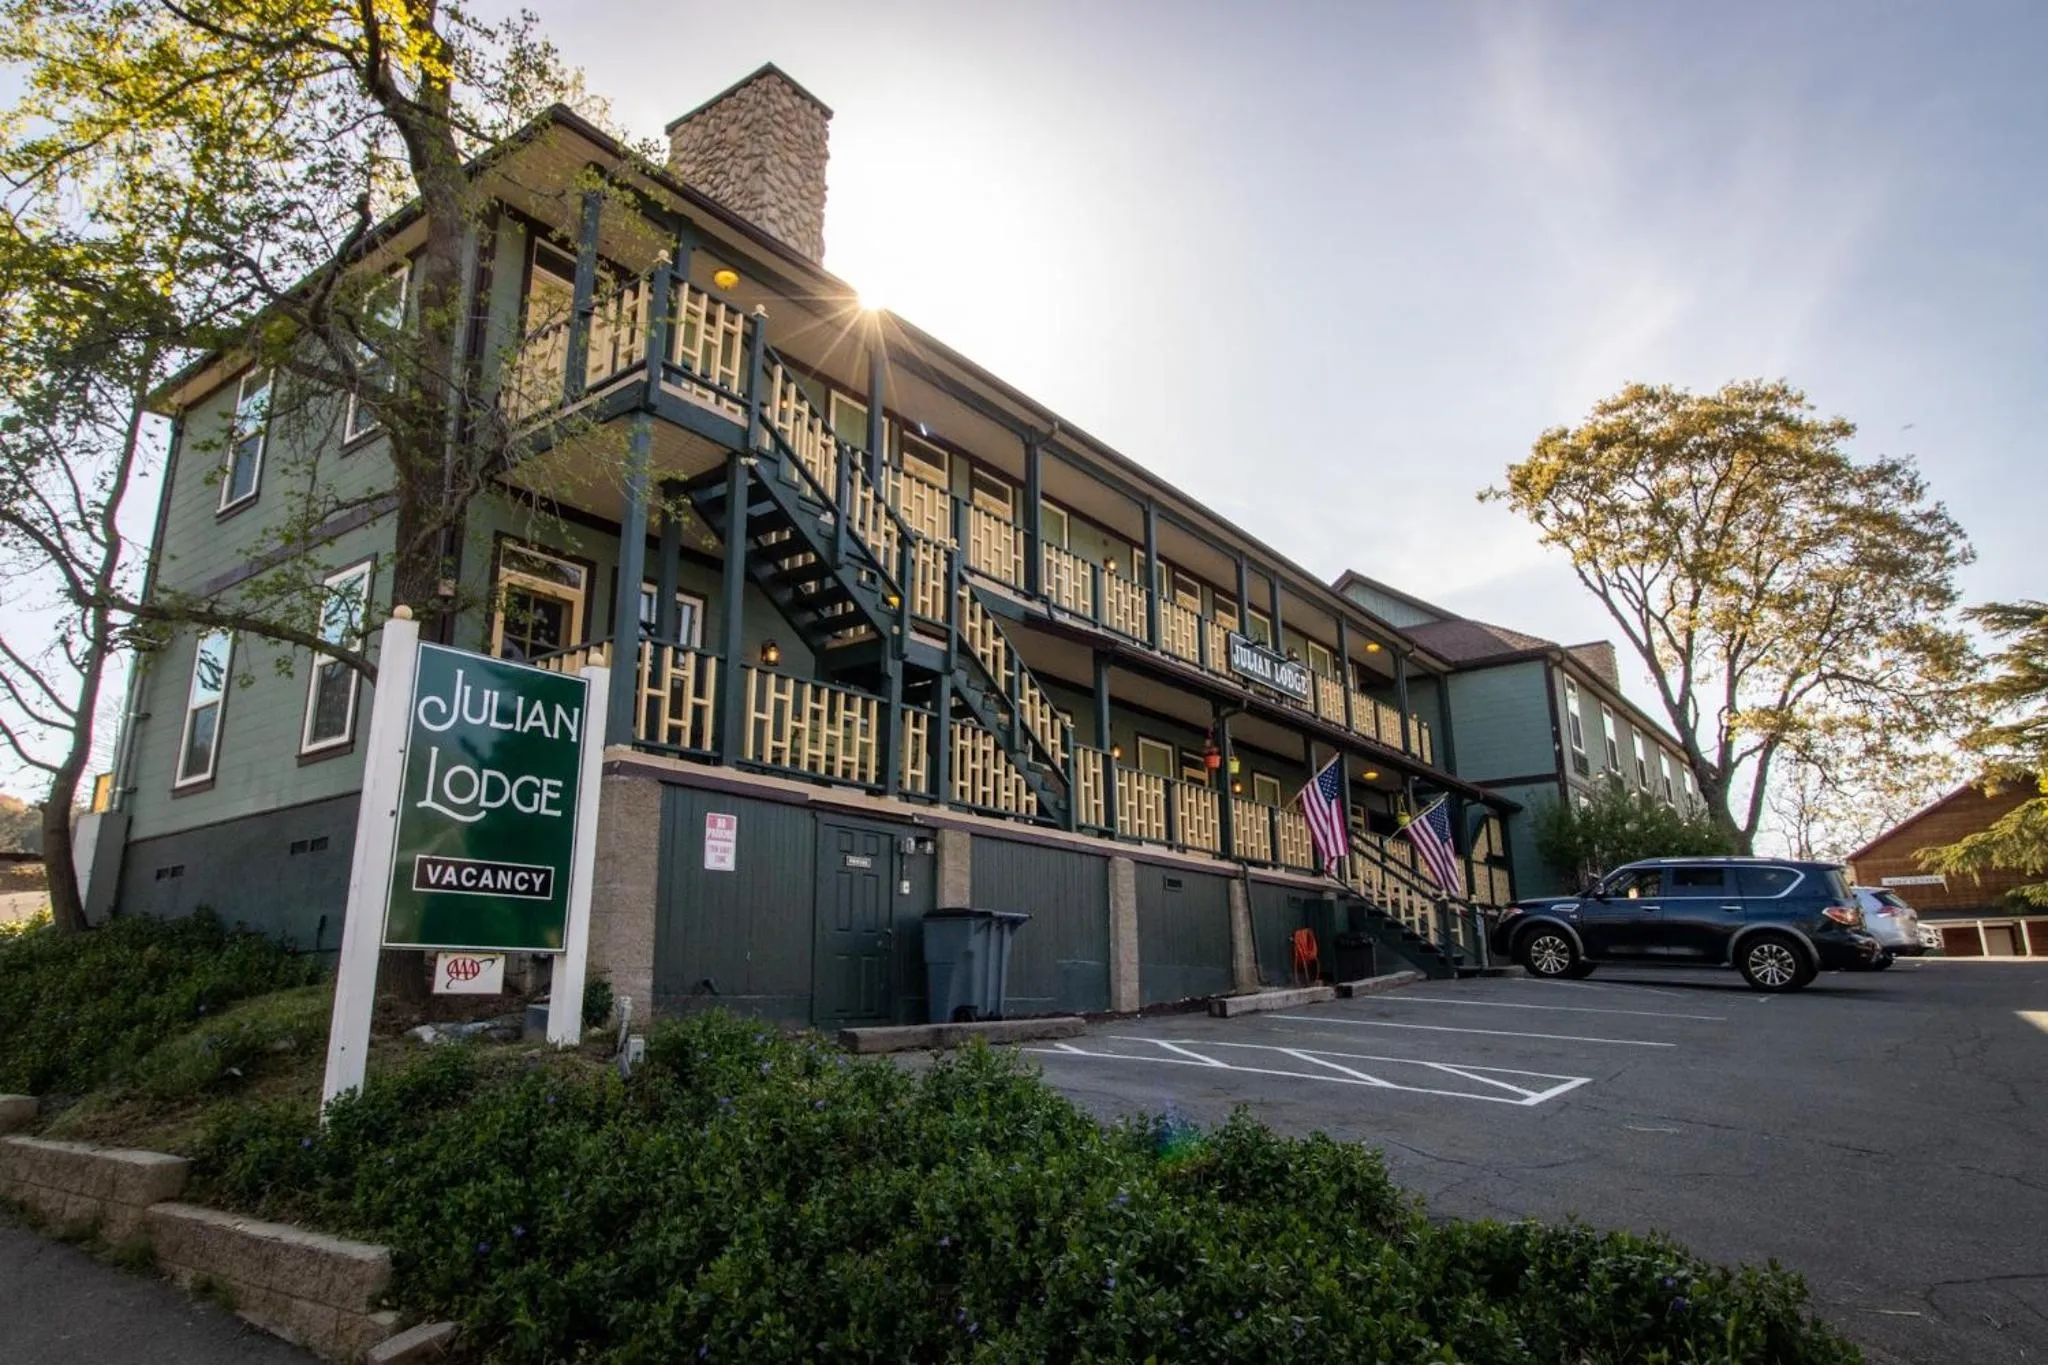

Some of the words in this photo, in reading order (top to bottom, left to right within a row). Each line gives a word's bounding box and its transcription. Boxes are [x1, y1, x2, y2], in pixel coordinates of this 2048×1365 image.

[1233, 644, 1271, 679] JULIAN
[1274, 662, 1307, 695] LODGE
[417, 669, 580, 742] JULIAN
[416, 746, 564, 823] LODGE
[426, 864, 545, 892] VACANCY
[448, 957, 480, 980] AAA
